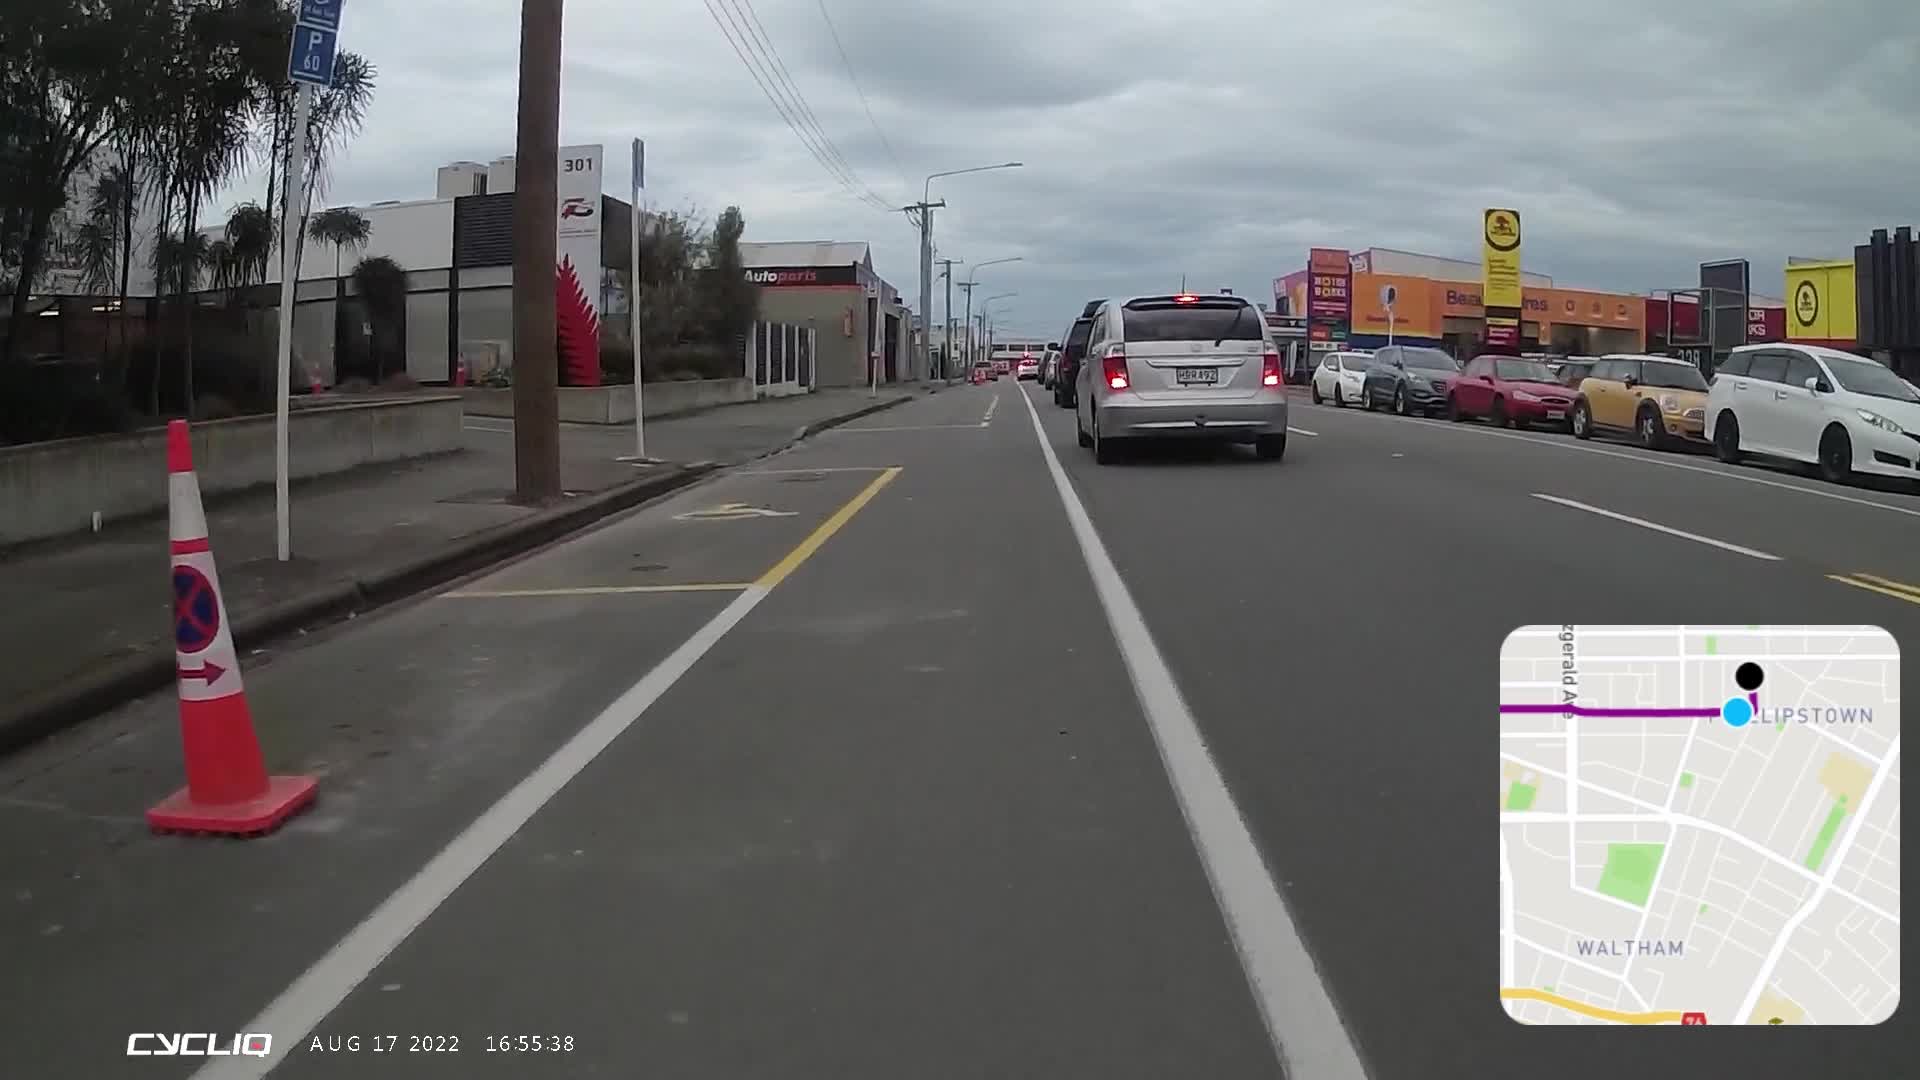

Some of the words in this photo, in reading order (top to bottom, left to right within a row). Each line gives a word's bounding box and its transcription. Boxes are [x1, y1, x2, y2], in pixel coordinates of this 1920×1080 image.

[309, 31, 323, 51] P
[303, 55, 321, 71] 60
[563, 158, 592, 172] 301
